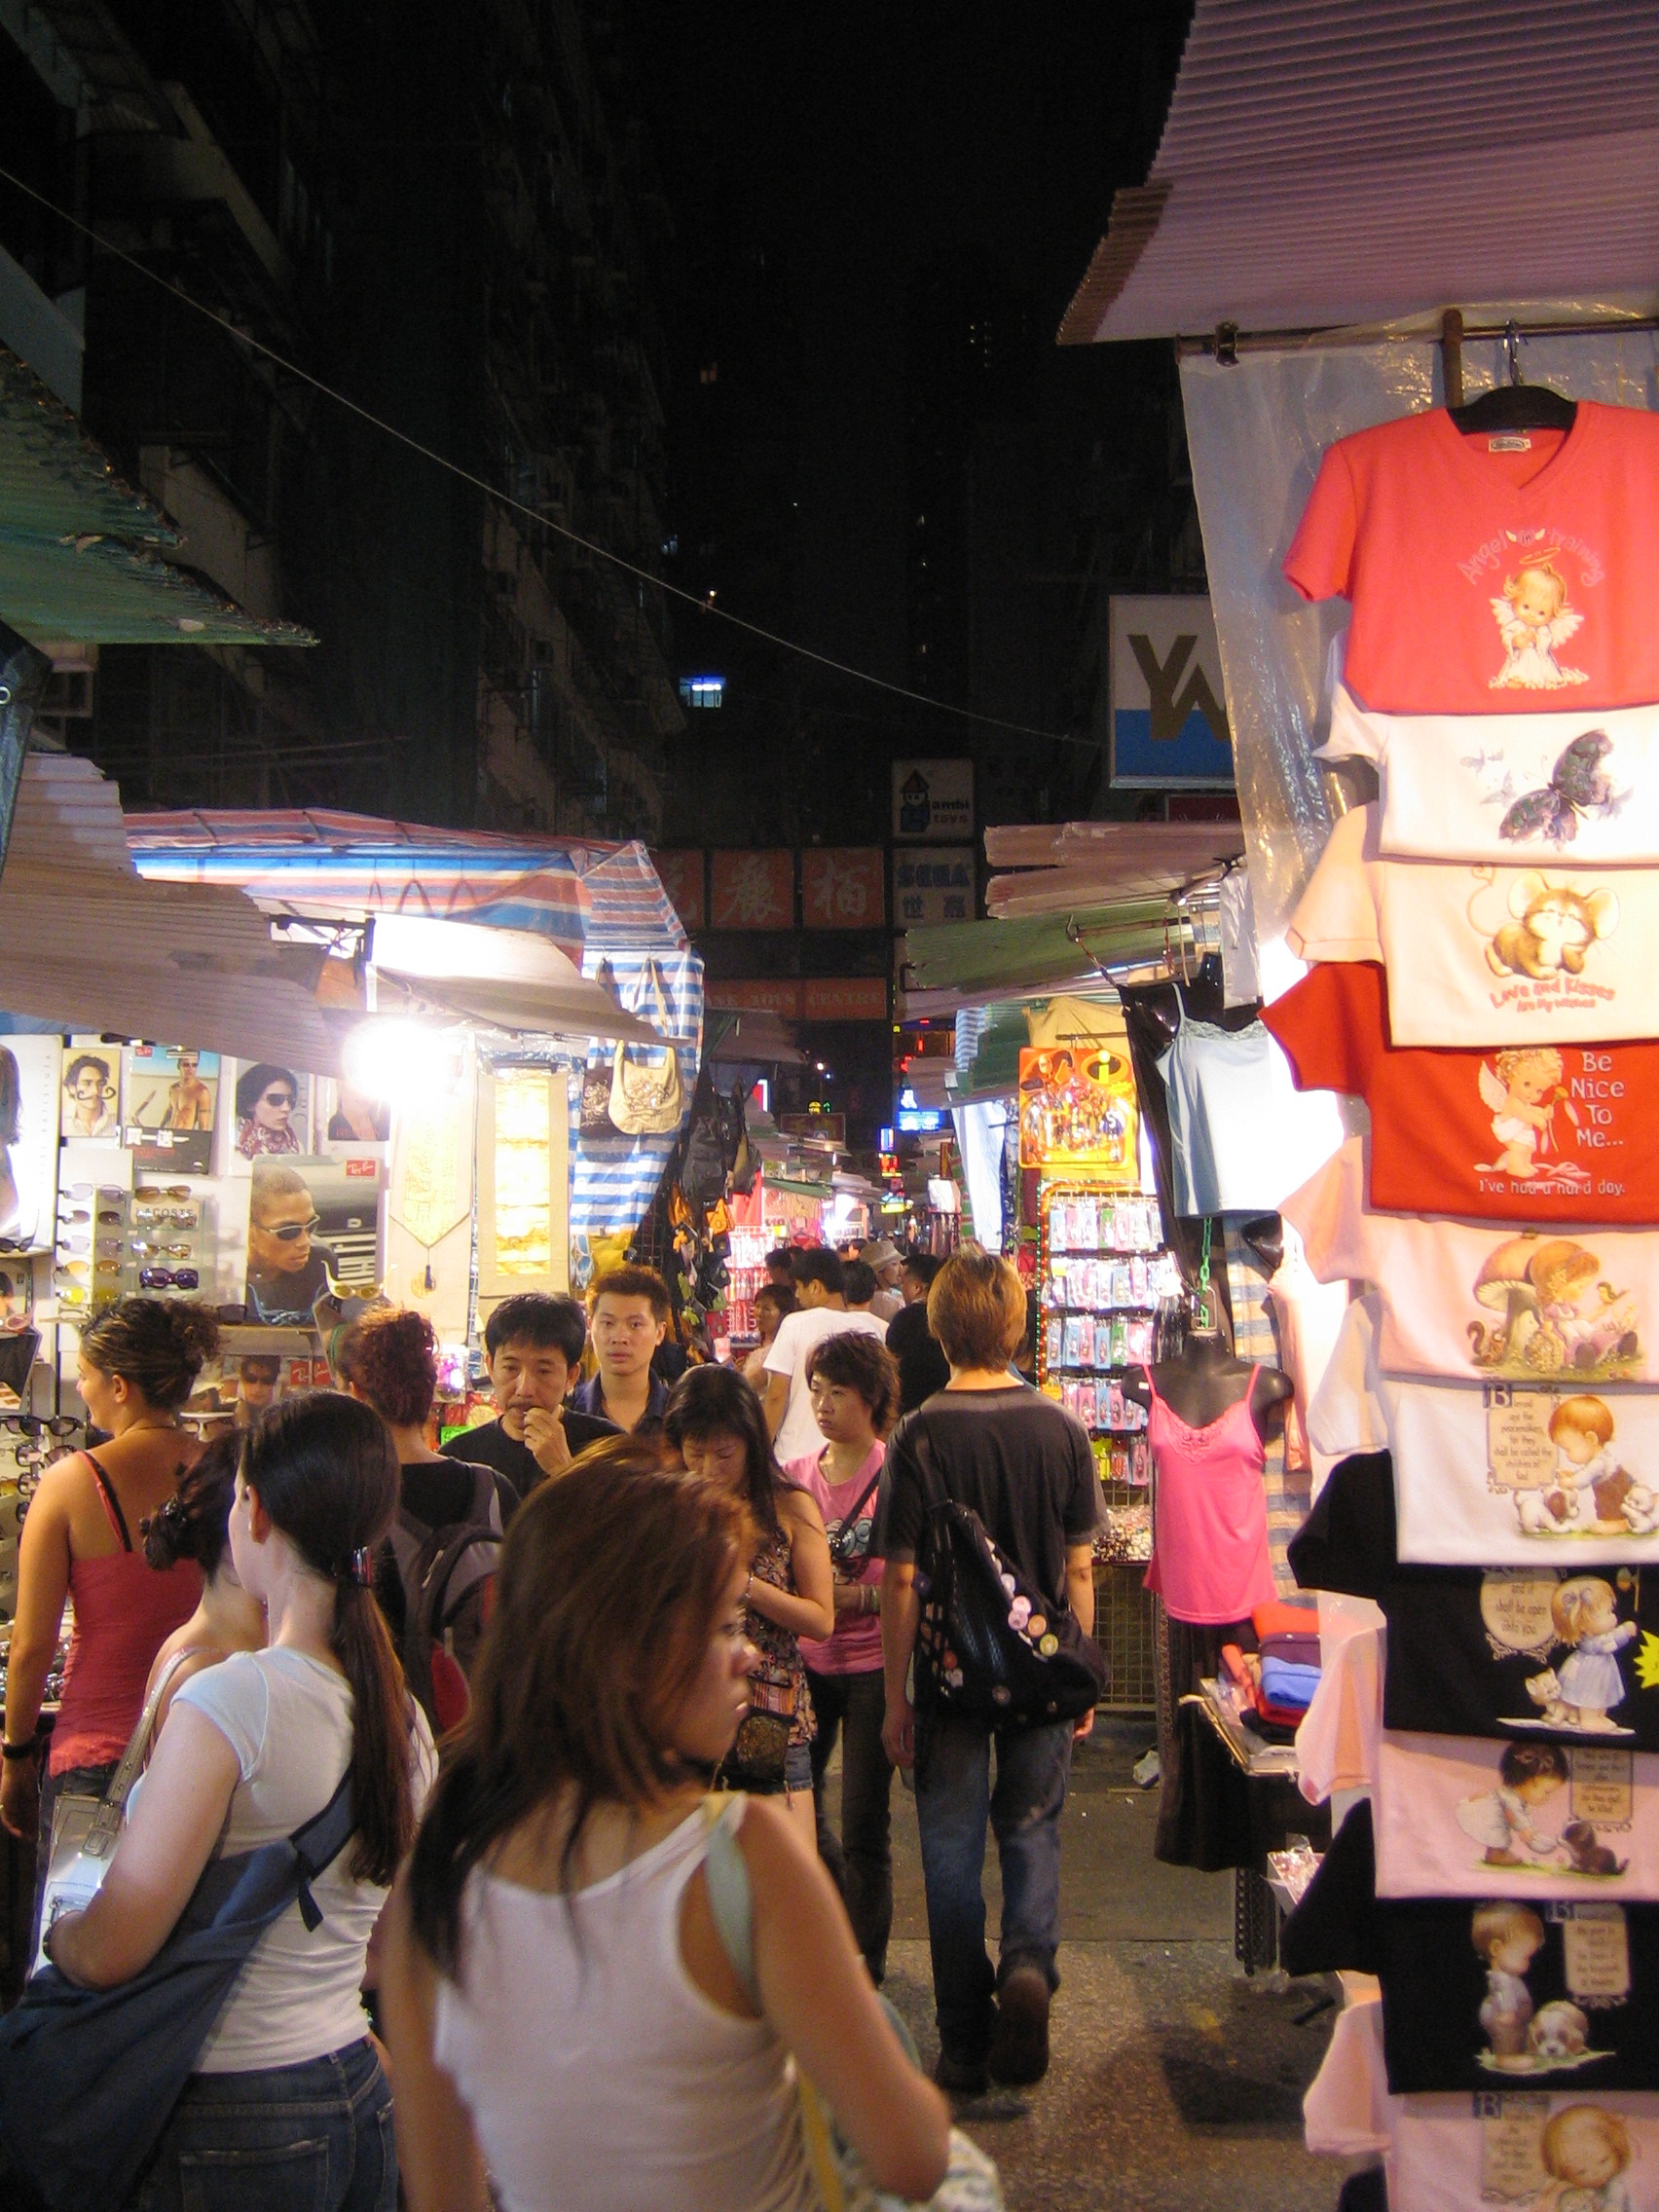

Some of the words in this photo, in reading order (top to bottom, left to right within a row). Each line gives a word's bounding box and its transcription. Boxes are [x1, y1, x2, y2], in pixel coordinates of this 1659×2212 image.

[933, 814, 969, 826] toys
[898, 865, 971, 888] SEGA
[1490, 983, 1530, 1010] Love
[1532, 977, 1561, 996] and
[1565, 976, 1616, 1001] Kisses
[1581, 1051, 1613, 1073] Be
[1570, 1076, 1625, 1100] Nice
[1584, 1104, 1613, 1125] To
[1576, 1127, 1625, 1149] Me...
[1479, 1178, 1505, 1194] I've
[1511, 1179, 1536, 1195] had
[1543, 1185, 1552, 1195] a
[1557, 1179, 1592, 1196] hard
[1598, 1179, 1626, 1198] day.
